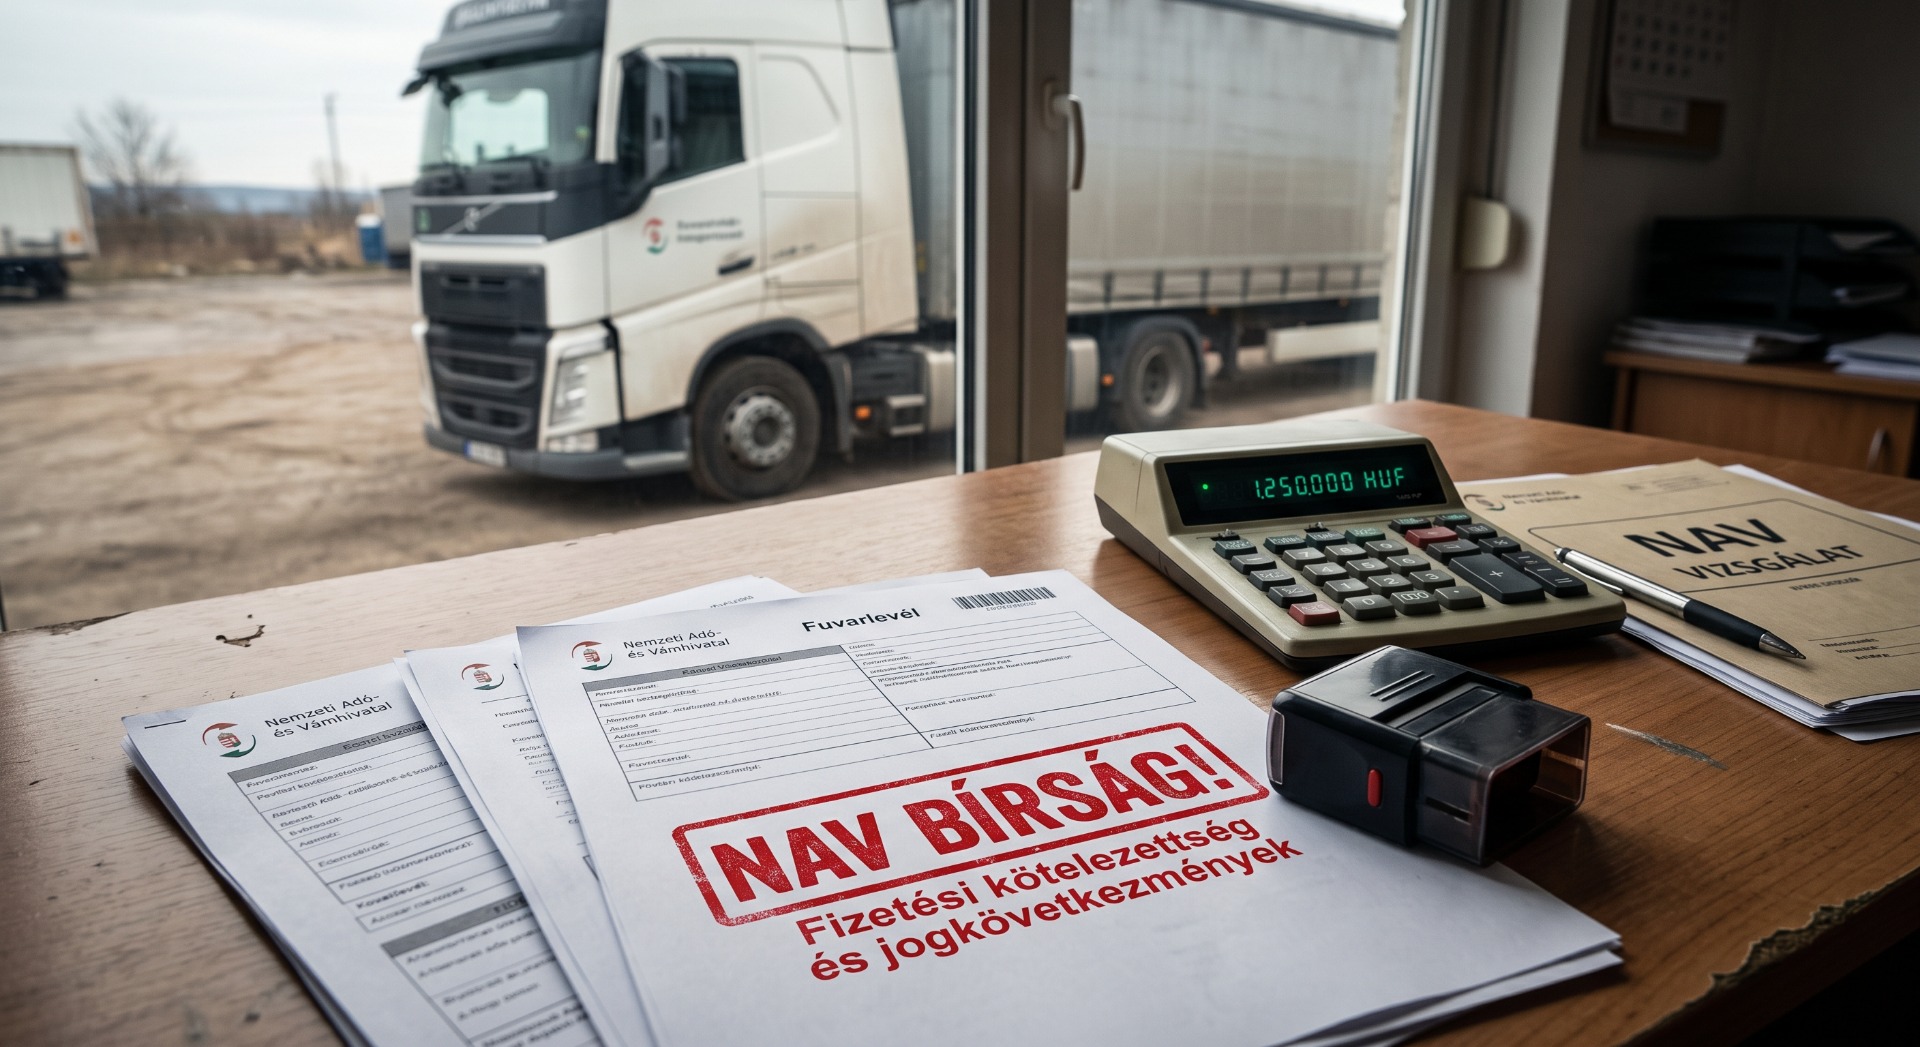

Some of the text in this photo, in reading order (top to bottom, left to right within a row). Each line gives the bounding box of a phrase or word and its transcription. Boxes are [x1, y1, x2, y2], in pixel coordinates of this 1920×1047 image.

[1255, 467, 1404, 500] 1.250.000 HUF
[1623, 518, 1788, 558] NAV
[1672, 544, 1864, 580] VIZSGÁLAT
[1383, 577, 1399, 585] 2
[1362, 598, 1375, 606] 0
[802, 607, 921, 632] Fuvarlevél
[623, 629, 722, 649] Nemzeti Adó-
[627, 637, 730, 659] és Vámhivatal
[264, 694, 380, 728] Nemzeti Adó-
[273, 701, 393, 738] és Vámhivatal
[710, 743, 1235, 903] NAV BÍRSÁG!
[796, 818, 1260, 945] Fizetési kötelezettség
[811, 836, 1303, 982] és jogkövetkezmények
